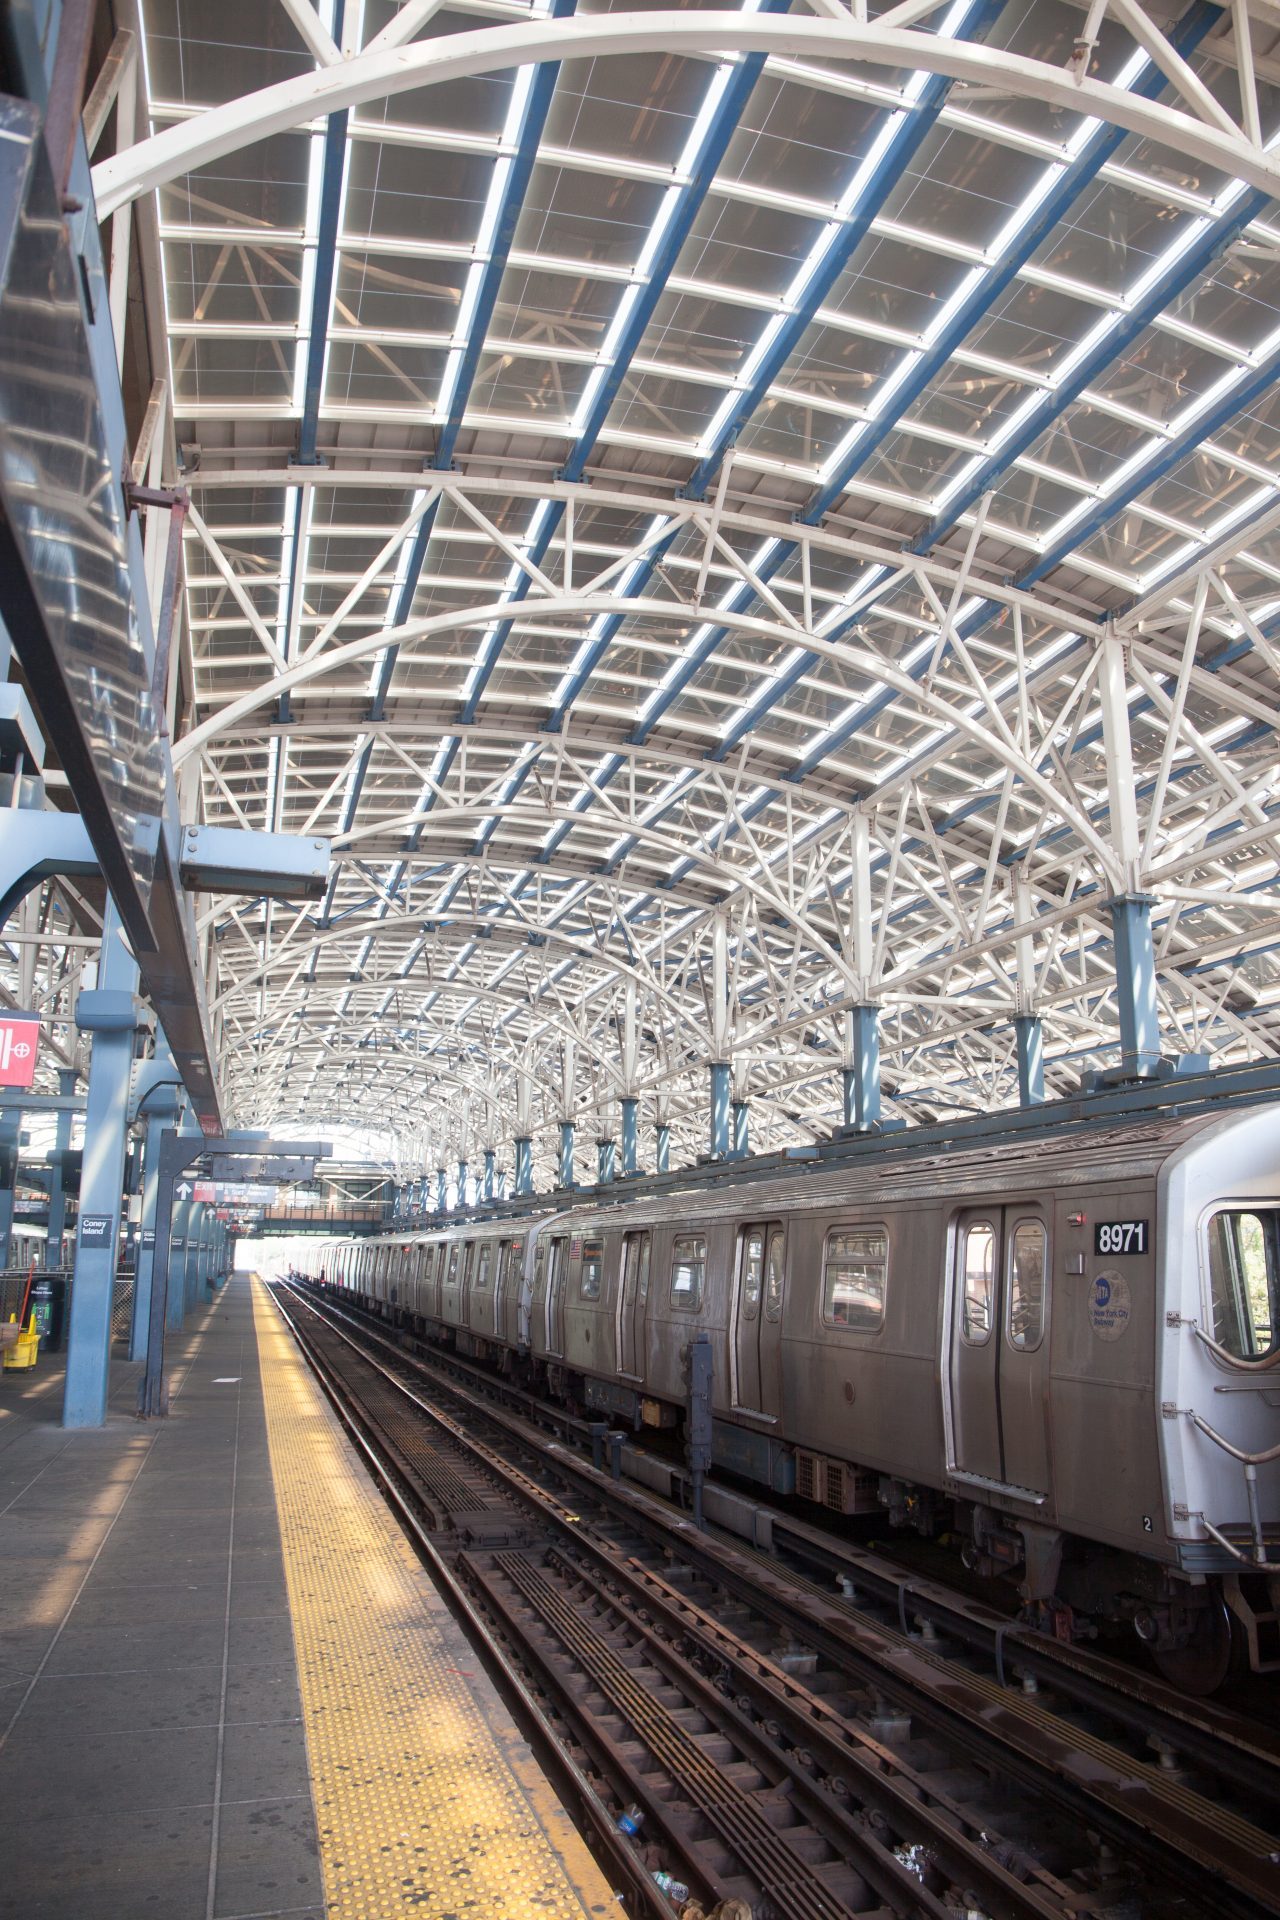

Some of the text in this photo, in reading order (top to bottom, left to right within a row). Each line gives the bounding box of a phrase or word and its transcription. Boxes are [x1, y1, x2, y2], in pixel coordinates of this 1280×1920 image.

[83, 1219, 106, 1229] Coney
[82, 1227, 104, 1235] Island
[1099, 1223, 1144, 1253] 8971
[1118, 1310, 1128, 1319] City
[1144, 1517, 1151, 1531] 2
